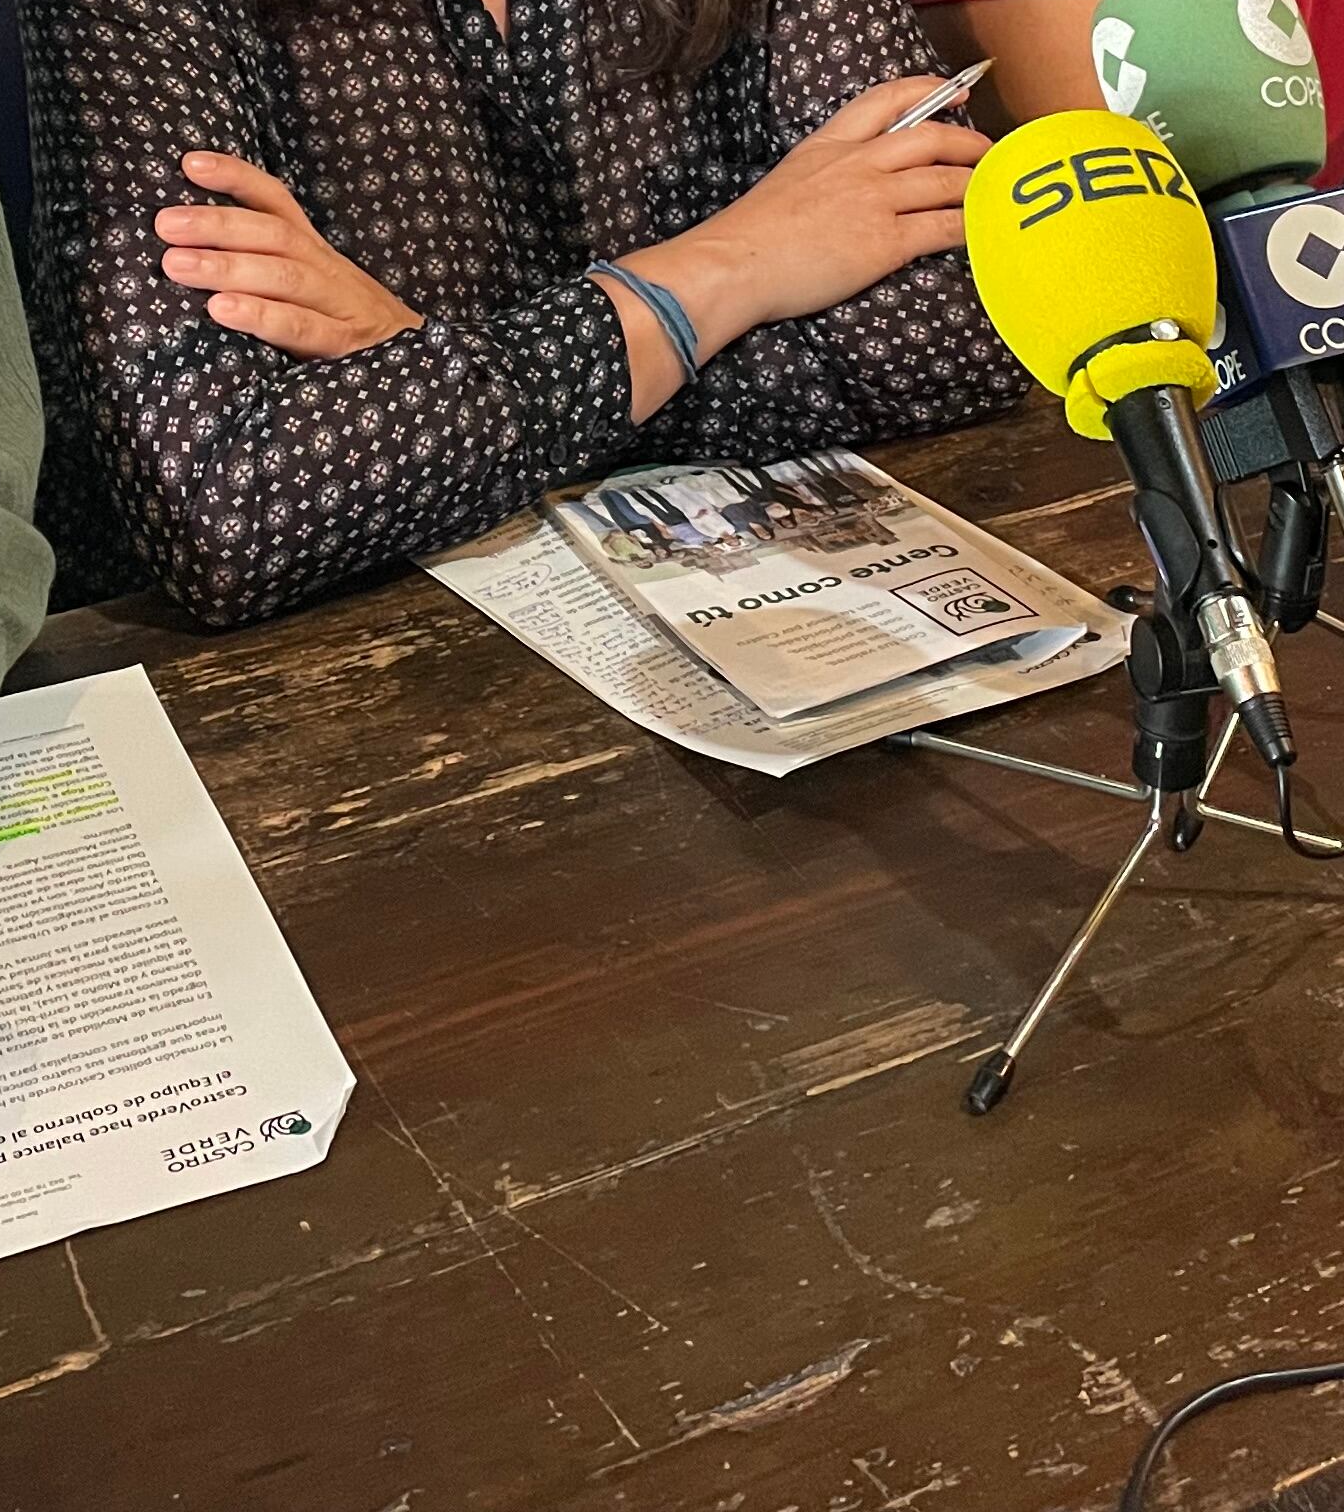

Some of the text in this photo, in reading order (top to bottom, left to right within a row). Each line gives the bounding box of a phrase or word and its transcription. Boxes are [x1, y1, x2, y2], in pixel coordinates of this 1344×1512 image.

[1214, 349, 1247, 395] OPE
[685, 544, 959, 627] Gente como tú
[149, 1075, 212, 1099] Equipo
[215, 1069, 231, 1084] el
[122, 1094, 145, 1107] de
[136, 1084, 247, 1122] CastroVerde
[32, 1103, 118, 1134] Gobierno
[88, 1117, 133, 1136] hace
[10, 1128, 27, 1143] al
[12, 1131, 85, 1159] balance
[159, 1126, 251, 1161] VERDE
[167, 1139, 255, 1173] CASTRO
